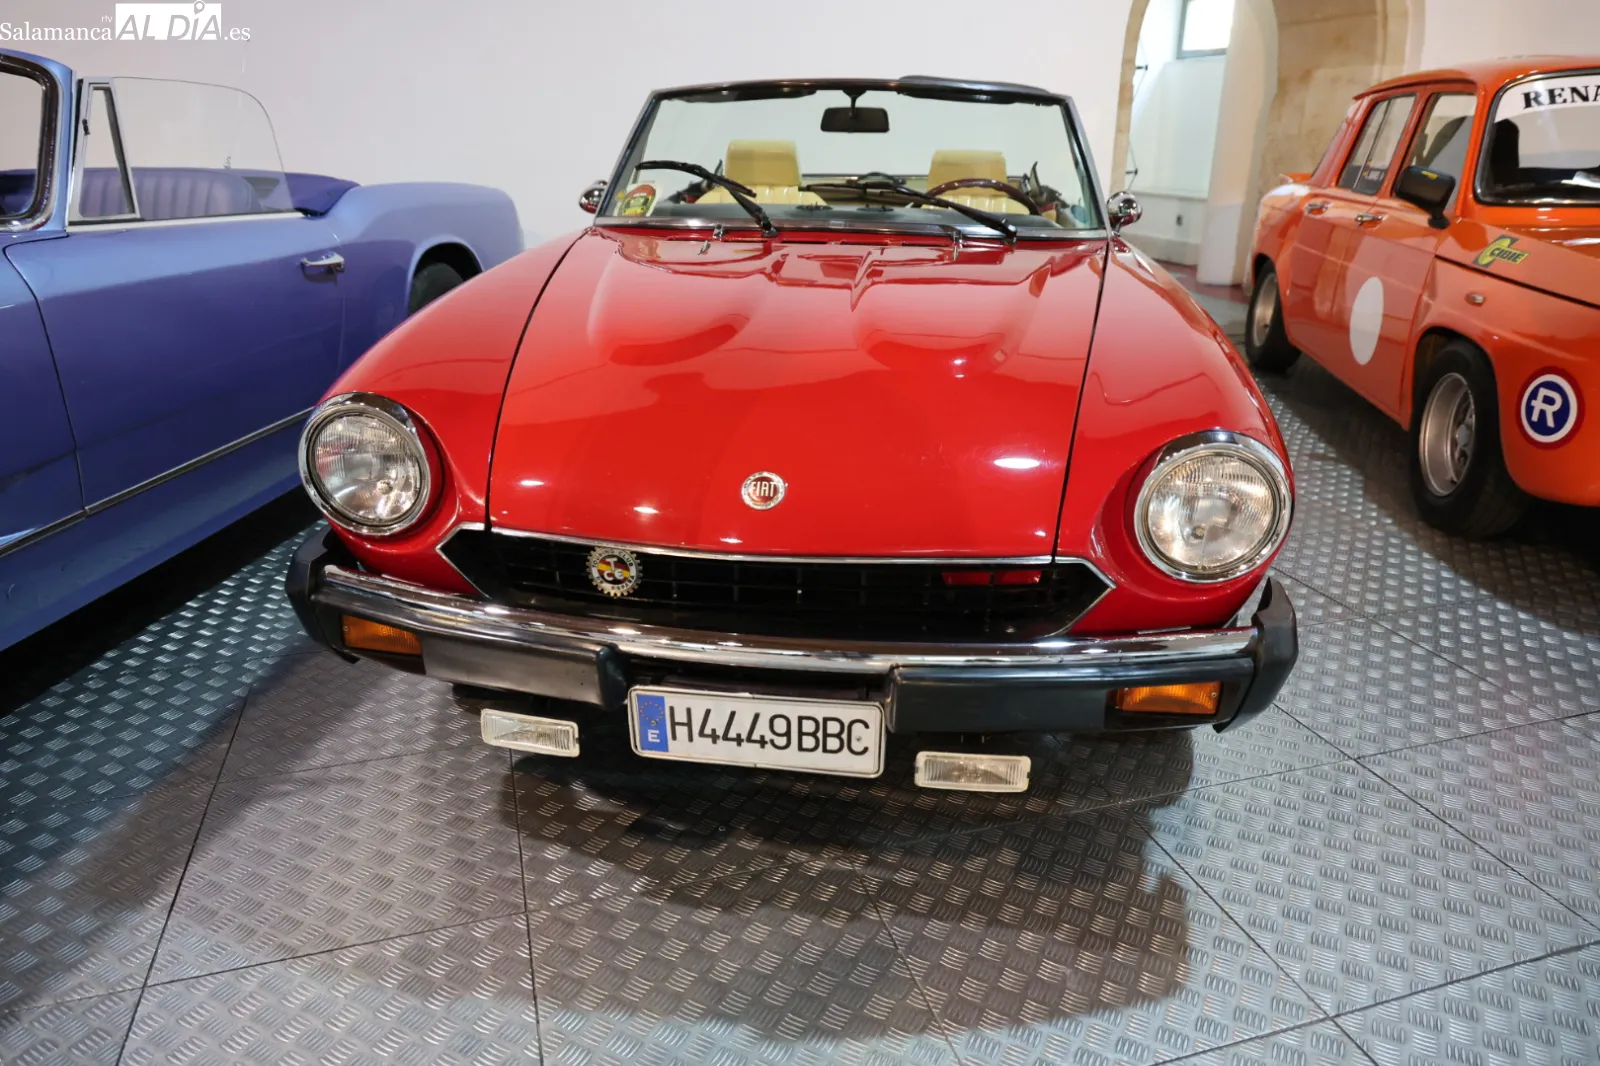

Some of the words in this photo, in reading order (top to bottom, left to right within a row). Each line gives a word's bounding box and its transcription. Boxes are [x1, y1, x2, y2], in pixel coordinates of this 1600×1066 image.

[1530, 387, 1563, 429] R
[750, 481, 777, 497] FIAT
[647, 729, 661, 744] E
[668, 705, 871, 757] H4449BBC
